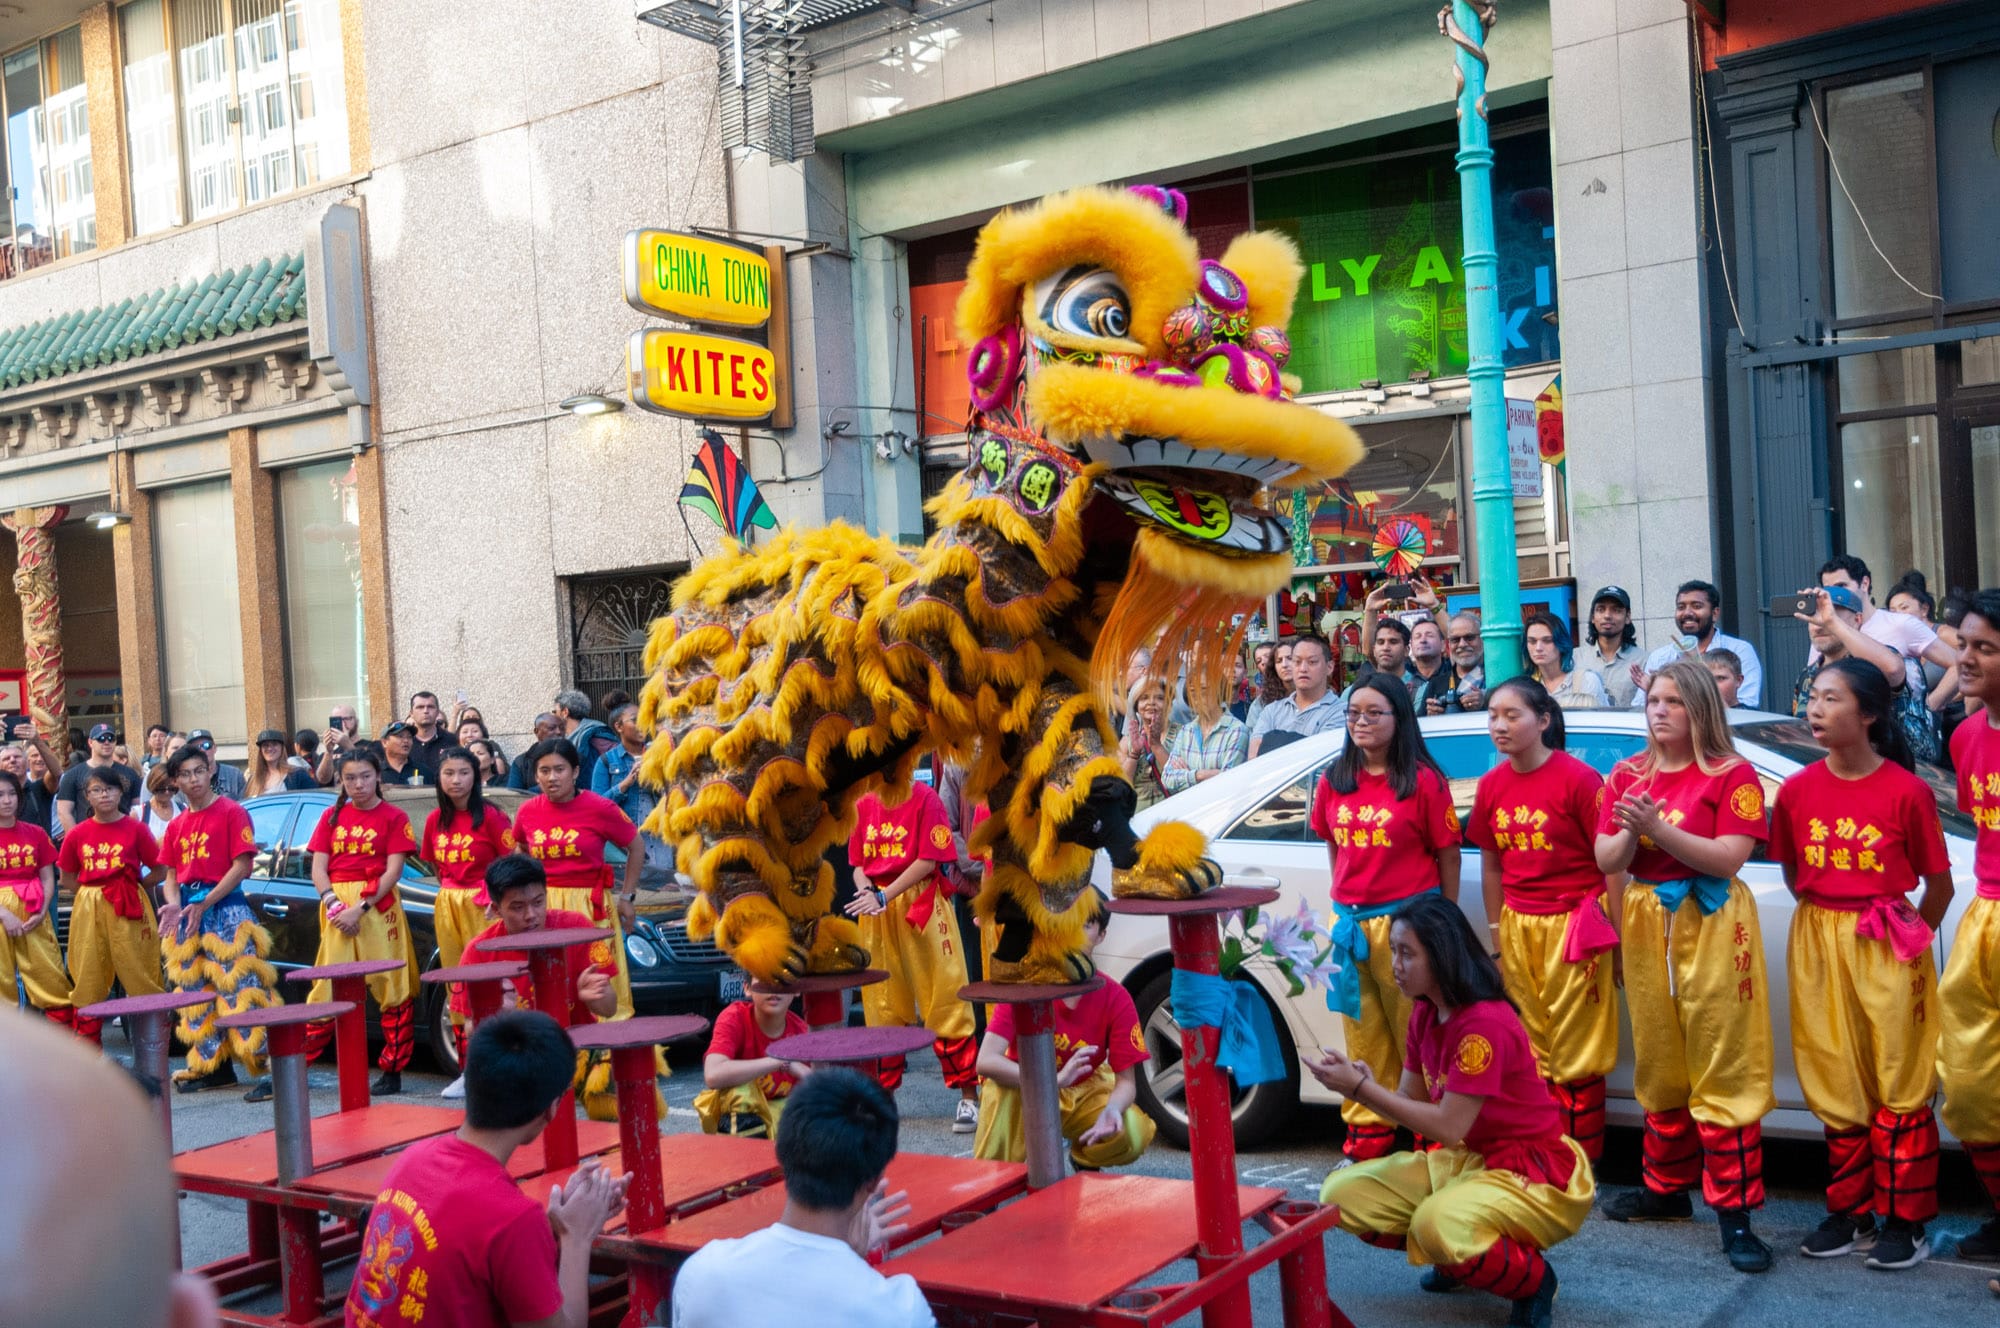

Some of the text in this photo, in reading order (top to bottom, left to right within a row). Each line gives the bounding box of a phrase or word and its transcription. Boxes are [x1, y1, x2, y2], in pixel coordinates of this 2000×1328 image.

[656, 244, 769, 309] CHINA TOWN
[1311, 254, 1382, 302] LY
[666, 346, 770, 402] KITES
[1509, 407, 1535, 427] PARKING
[1804, 844, 1885, 873] 劉世民
[392, 1189, 418, 1216] KUNG
[413, 1208, 439, 1252] MOON
